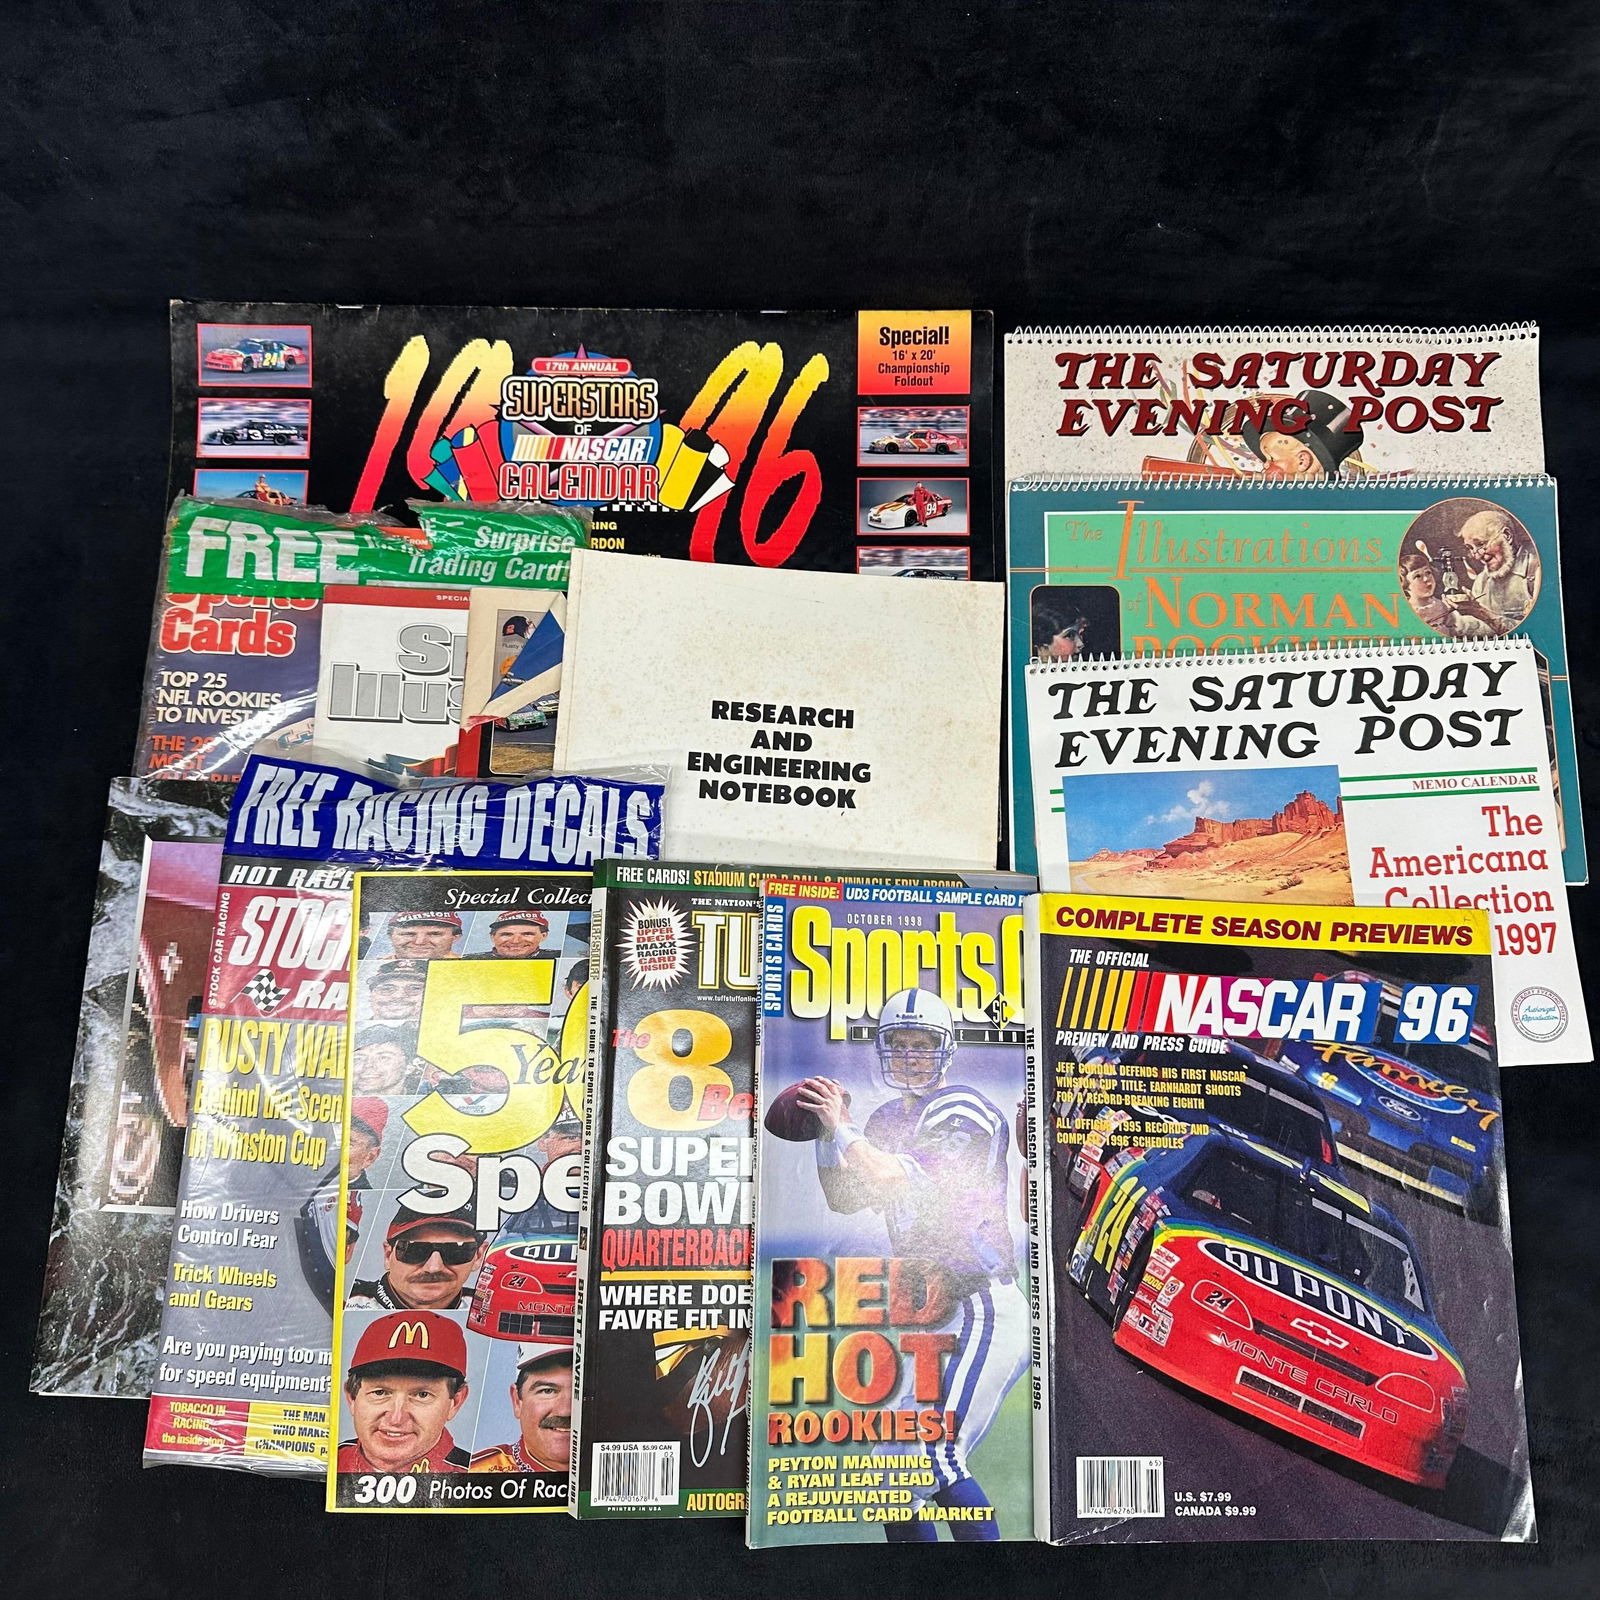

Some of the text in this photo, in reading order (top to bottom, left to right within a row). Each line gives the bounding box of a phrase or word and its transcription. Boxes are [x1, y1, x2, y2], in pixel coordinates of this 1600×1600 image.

[880, 326, 950, 346] Special!
[545, 361, 619, 373] 17th ANNUAL
[892, 349, 936, 361] 16' 20'
[878, 363, 950, 376] Championship
[895, 375, 934, 387] Foldout
[1055, 350, 1502, 397] THE SATURDAY
[506, 381, 657, 421] SUPERSTARS
[1057, 394, 1504, 437] EVENING POST
[574, 424, 592, 435] OF
[560, 437, 646, 461] NASCAR
[500, 463, 659, 500] CALENDAR
[186, 515, 577, 583] FREE Surprise
[1065, 500, 1384, 581] The Illustrations
[408, 555, 498, 583] Trading
[1144, 576, 1403, 629] NORMAN
[160, 607, 298, 655] Cards
[161, 671, 228, 688] TOP 25
[1048, 660, 1518, 721] THE SATURDAY
[157, 689, 282, 708] NFL ROOKIES
[157, 707, 182, 722] TO
[711, 700, 854, 729] RESEARCH
[750, 729, 813, 752] AND
[1055, 708, 1524, 768] EVENING POST
[687, 751, 871, 784] ENGINEERING
[1412, 772, 1538, 791] MEMO CALENDAR
[699, 779, 856, 809] NOTEBOOK
[233, 763, 654, 866] FREE RACING DECALS
[1482, 805, 1544, 837] The
[1369, 846, 1549, 879] Americana
[227, 865, 278, 885] HOT
[616, 866, 745, 888] FREE CARDS! STADIUM
[444, 887, 520, 911] Special
[691, 898, 712, 906] THE
[768, 881, 1017, 907] FREE INSIDE: UD3 FOOTBALL SAMPLE CARD
[637, 927, 673, 936] UPPER
[638, 917, 671, 929] BONUS!
[847, 913, 922, 927] OCTOBER 1998
[1056, 906, 1473, 946] COMPLETE SEASON PREVIEWS
[208, 892, 229, 1008] STOCK CAR RACING
[636, 934, 675, 943] DECK
[636, 941, 677, 950] MAXX
[1497, 921, 1558, 955] 1997
[637, 948, 677, 958] RACING
[638, 956, 677, 965] CARD
[764, 903, 784, 1012] SPORTS CARDS
[1069, 948, 1149, 968] THE OFFICIAL
[640, 963, 676, 972] INSIDE
[1154, 974, 1374, 1043] NASCAR
[1400, 985, 1475, 1043] 96
[200, 1018, 290, 1076] RUSTY
[612, 1029, 651, 1049] The
[1055, 1030, 1227, 1054] PREVIEW AND PRESS GUIDE
[627, 1009, 734, 1132] 8
[1056, 1062, 1246, 1082] JEFF DEFENDS HIS FIRST NASCAR
[194, 1079, 260, 1119] Behind
[586, 1071, 595, 1104] SPORTS
[1121, 1080, 1242, 1096] TITLE; EARNHARDT SHOOTS
[1056, 1092, 1205, 1109] FOR EIGHTH
[1145, 1121, 1209, 1135] RECORDS AND
[213, 1127, 328, 1171] Winston Cup
[1133, 1136, 1184, 1149] SCHEDULES
[180, 1200, 280, 1225] How Drivers
[177, 1224, 279, 1250] Control Fear
[1026, 1056, 1042, 1410] OFFICIAL PREVIEW PRESS GUIDE 1996
[173, 1262, 278, 1289] Trick Wheels
[509, 1275, 527, 1288] 24
[169, 1290, 254, 1313] and Gears
[599, 1284, 693, 1306] WHERE
[771, 1257, 949, 1329] RED
[598, 1309, 718, 1331] FAVRE FIT
[1293, 1270, 1411, 1347] PONT
[162, 1335, 314, 1366] Are you paying too
[159, 1363, 238, 1389] for speed
[769, 1331, 957, 1405] HOT
[1218, 1331, 1399, 1425] MONTE CARLO
[169, 1401, 212, 1415] TOBACCO
[768, 1410, 956, 1445] ROOKIES!
[600, 1444, 621, 1452] $4.99
[768, 1455, 932, 1473] PEYTON MANNING
[354, 1475, 528, 1503] 300 Photos Of
[768, 1472, 935, 1490] & RYAN LEAF LEAD
[767, 1490, 912, 1507] A REJUVENATED
[1174, 1491, 1231, 1503] U.S. $7.99
[768, 1506, 995, 1525] FOOTBALL CARD MARKET
[1174, 1506, 1257, 1517] CANADA $9.99
